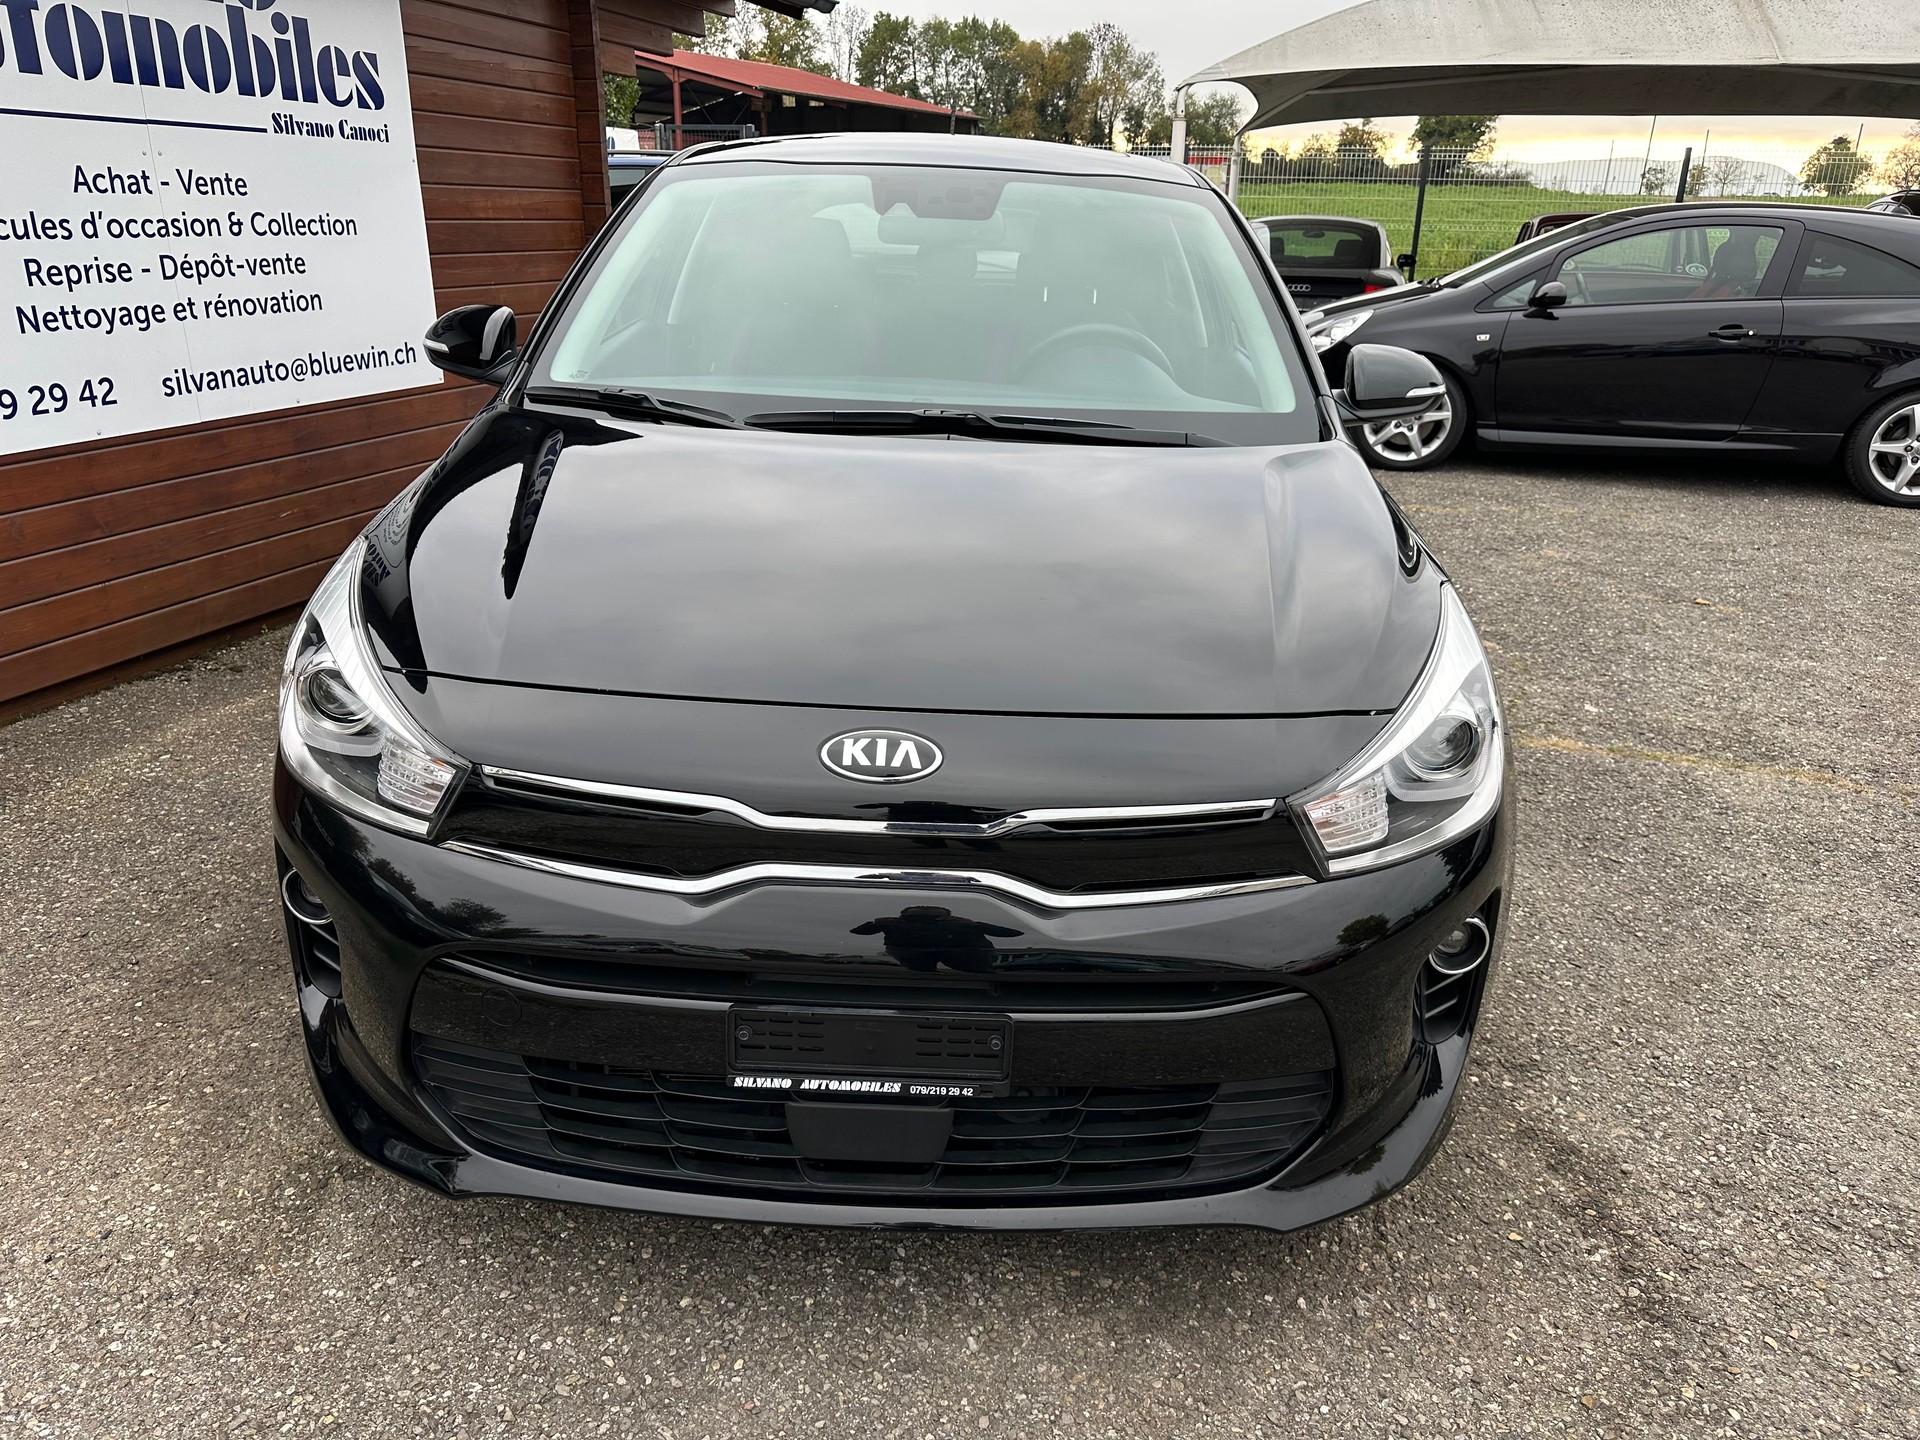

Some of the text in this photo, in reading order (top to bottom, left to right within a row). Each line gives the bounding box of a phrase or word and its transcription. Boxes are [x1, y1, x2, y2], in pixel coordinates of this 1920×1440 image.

[0, 0, 385, 111] tomobiles
[271, 112, 390, 144] Silvano Canoci
[73, 164, 154, 195] Achat
[175, 168, 249, 197] Vente
[80, 211, 222, 241] d'occasion
[227, 211, 244, 237] &
[250, 212, 358, 237] Collection
[23, 256, 133, 292] Reprise
[158, 252, 307, 285] Dépôt-vente
[15, 289, 323, 335] Nettoyage et rénovation
[161, 341, 417, 398] silvanauto@bluewin.ch
[27, 382, 68, 416] 29
[78, 376, 118, 408] 42
[842, 738, 922, 769] KIA
[733, 1076, 974, 1097] SILVANO AUTOMOBILES 079/219 29 42
